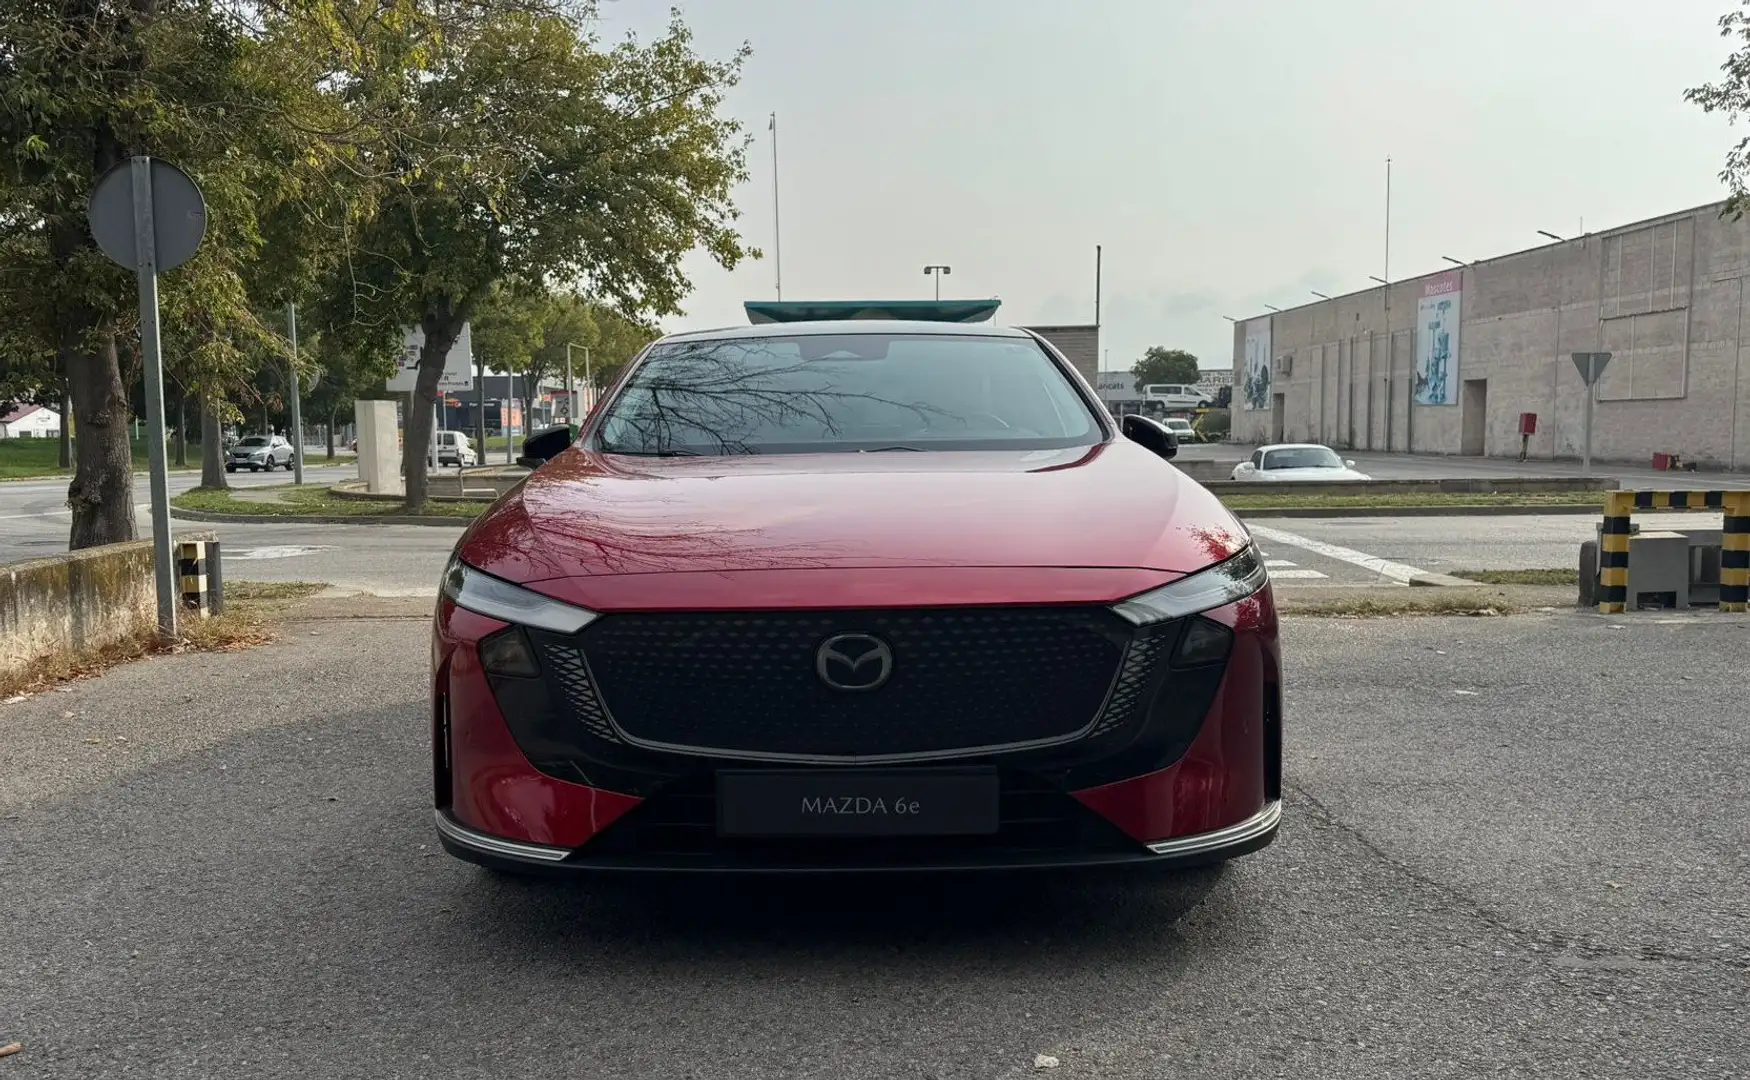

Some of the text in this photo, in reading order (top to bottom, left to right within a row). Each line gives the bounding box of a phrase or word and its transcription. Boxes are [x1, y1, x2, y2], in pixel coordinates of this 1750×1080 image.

[1424, 281, 1453, 297] Mascotes
[801, 797, 920, 814] MAZDA 6e
